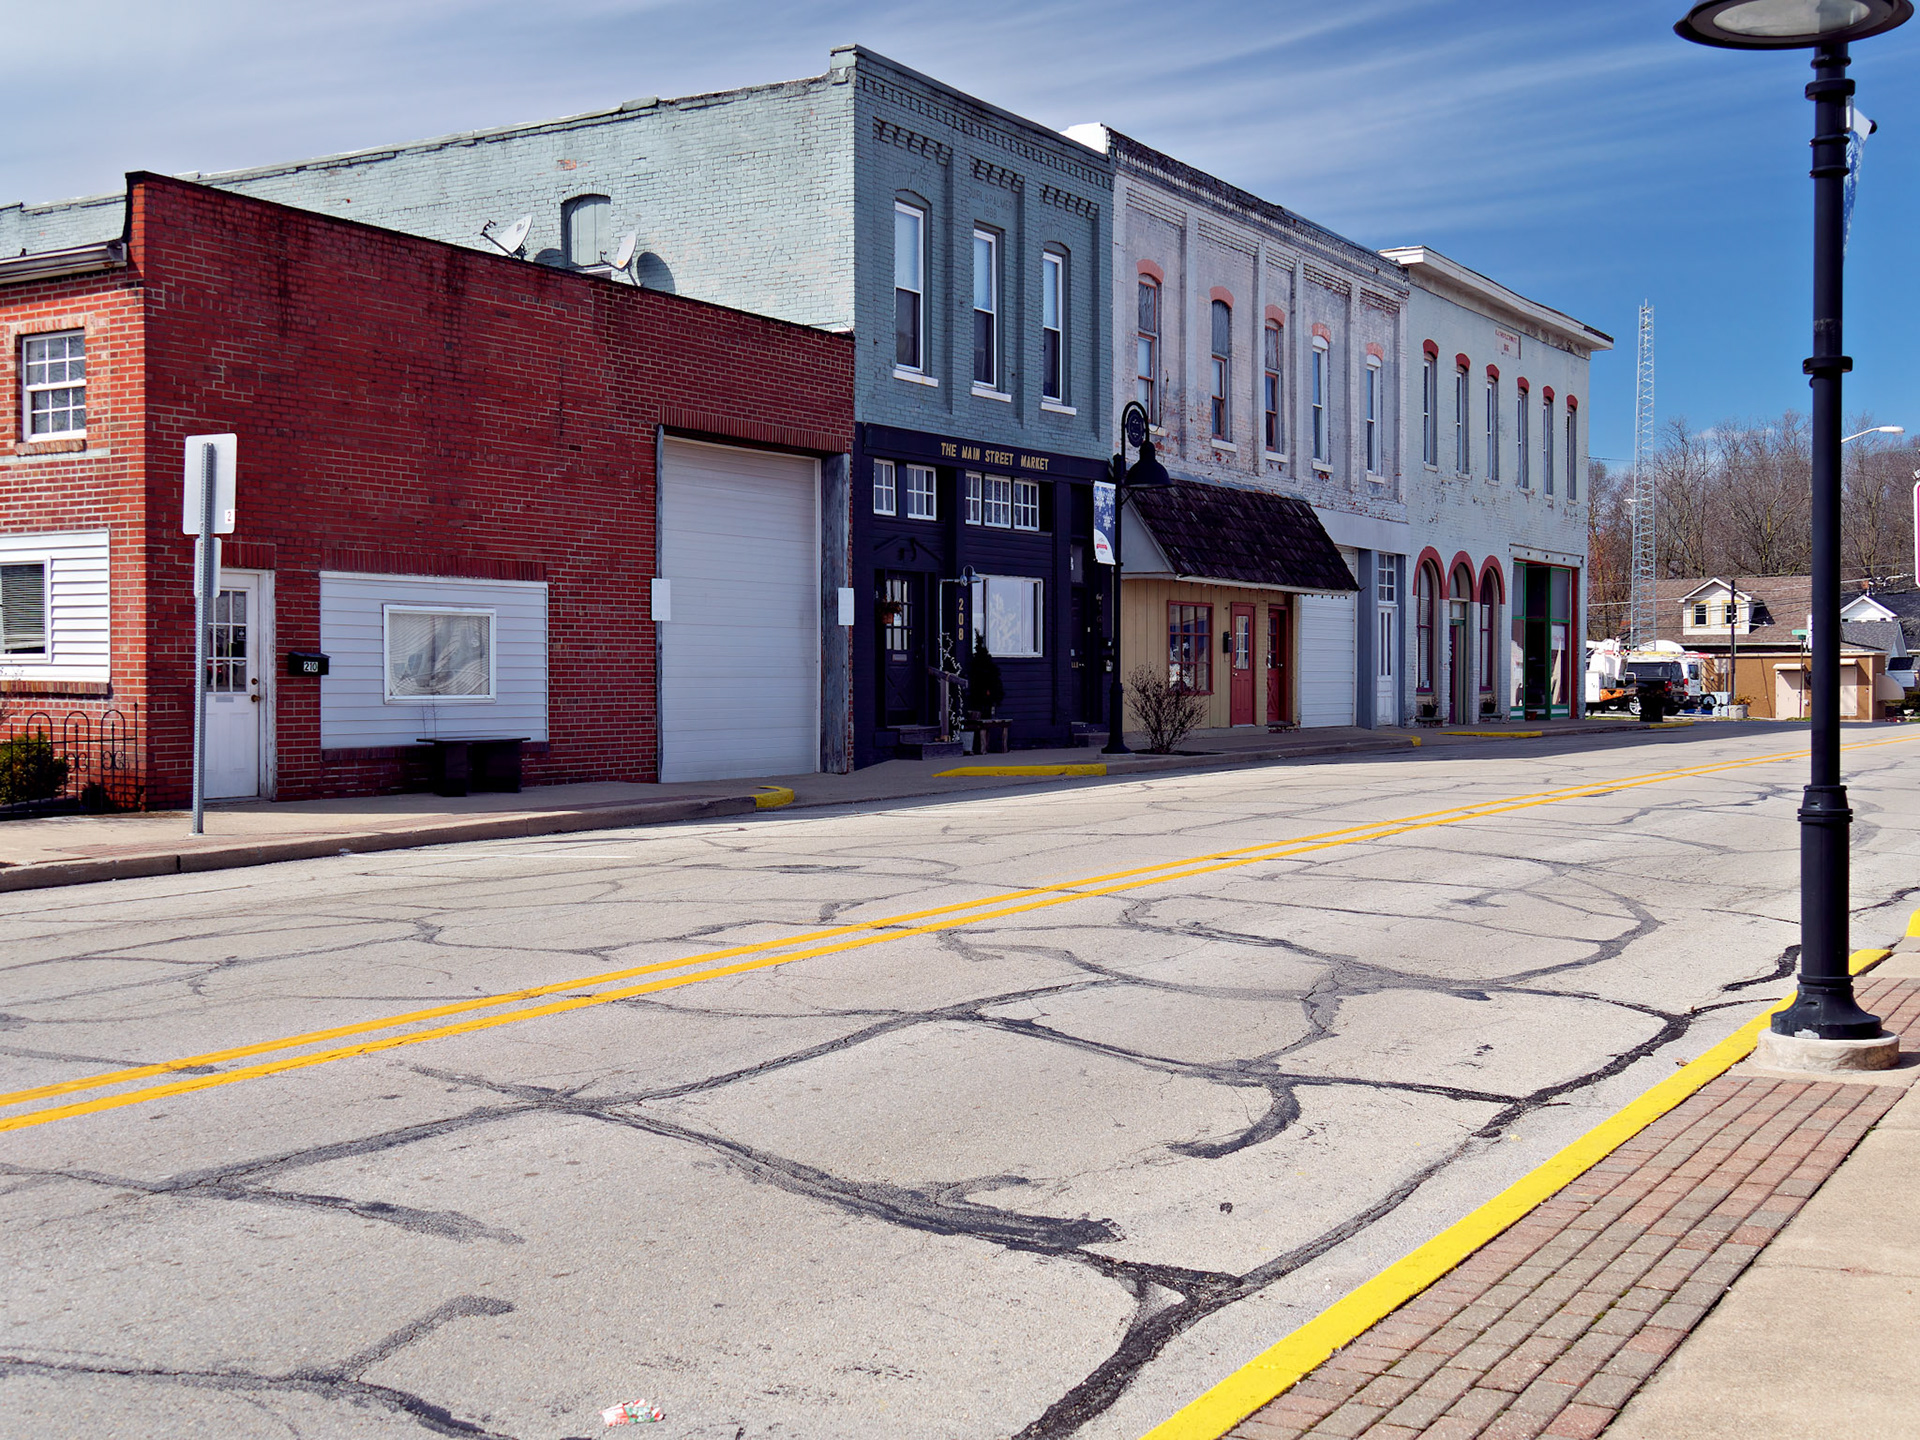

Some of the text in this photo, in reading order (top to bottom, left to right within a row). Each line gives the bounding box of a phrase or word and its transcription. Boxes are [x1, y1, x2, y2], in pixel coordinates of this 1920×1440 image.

[941, 442, 1049, 471] THE MAIN STREET MARKET
[303, 661, 318, 672] 210
